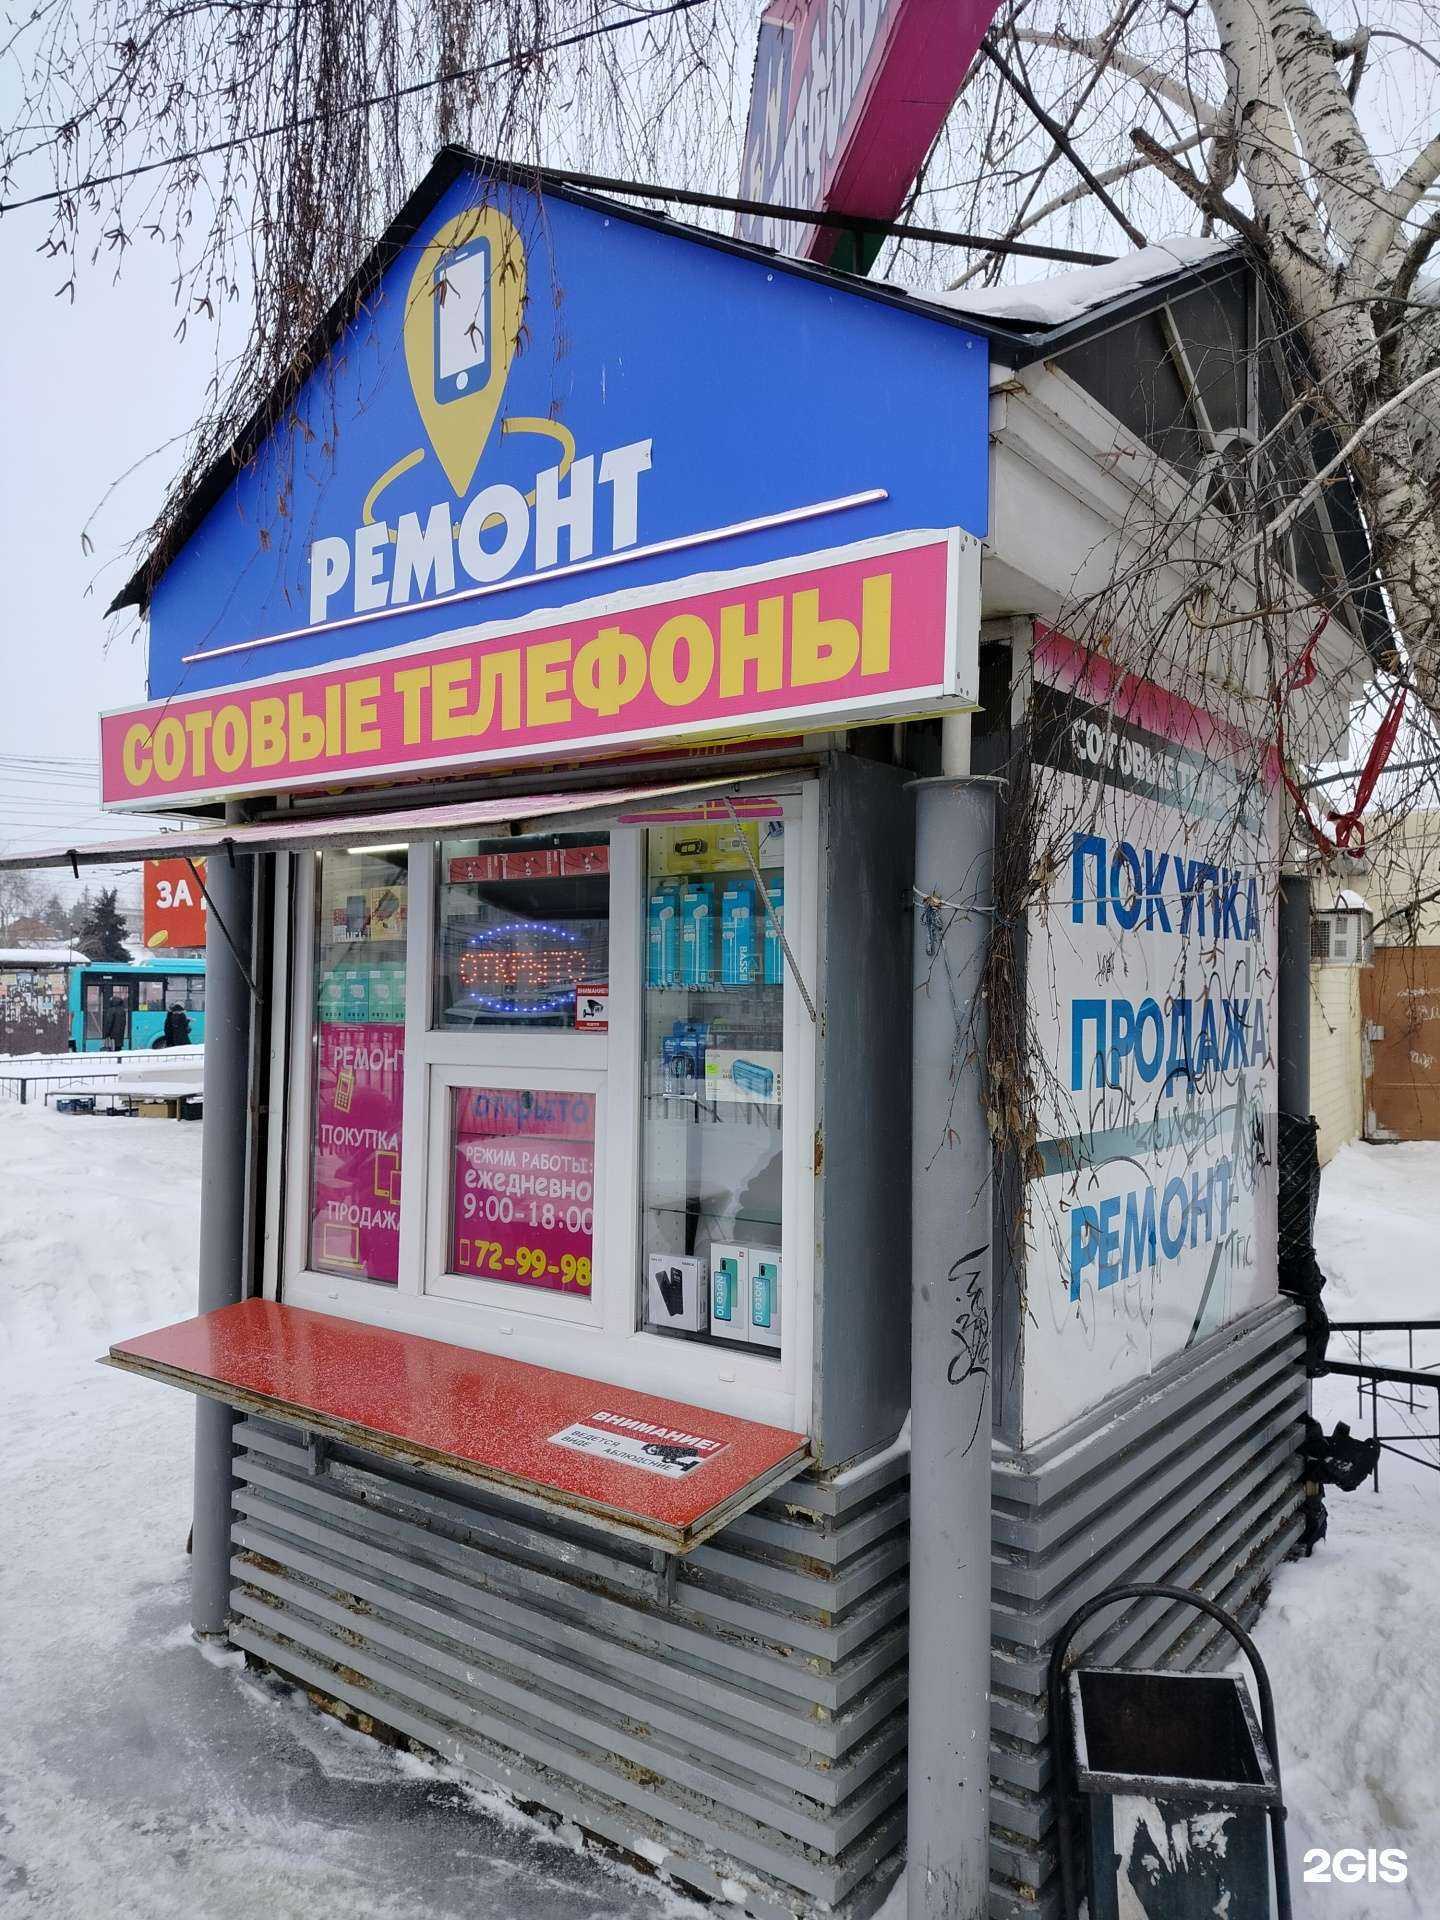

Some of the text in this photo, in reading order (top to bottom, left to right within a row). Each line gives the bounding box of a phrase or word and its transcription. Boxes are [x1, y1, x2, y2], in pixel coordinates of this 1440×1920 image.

[309, 438, 653, 626] РЕМОНТ
[122, 573, 893, 787] СОТОВЫЕ ТЕЛЕФОНЫ
[155, 879, 193, 909] ЗА
[1072, 832, 1260, 942] ПОКУПКА
[460, 950, 586, 985] ОТКРЫТО
[1071, 998, 1267, 1097] ПРОДАЖА
[321, 1124, 399, 1151] ПОКУПКА
[466, 1146, 516, 1167] РЕЖИМ
[465, 1171, 591, 1202] ежедневно
[327, 1200, 400, 1232] ПРОДАЖ
[463, 1193, 593, 1235] 9:00-18:00
[1070, 1159, 1233, 1303] РЕМОНТ
[474, 1240, 592, 1287] 72-99-98
[571, 1429, 621, 1448] ВЕДЕТСЯ
[591, 1411, 721, 1451] ВНИМАНИЕ!
